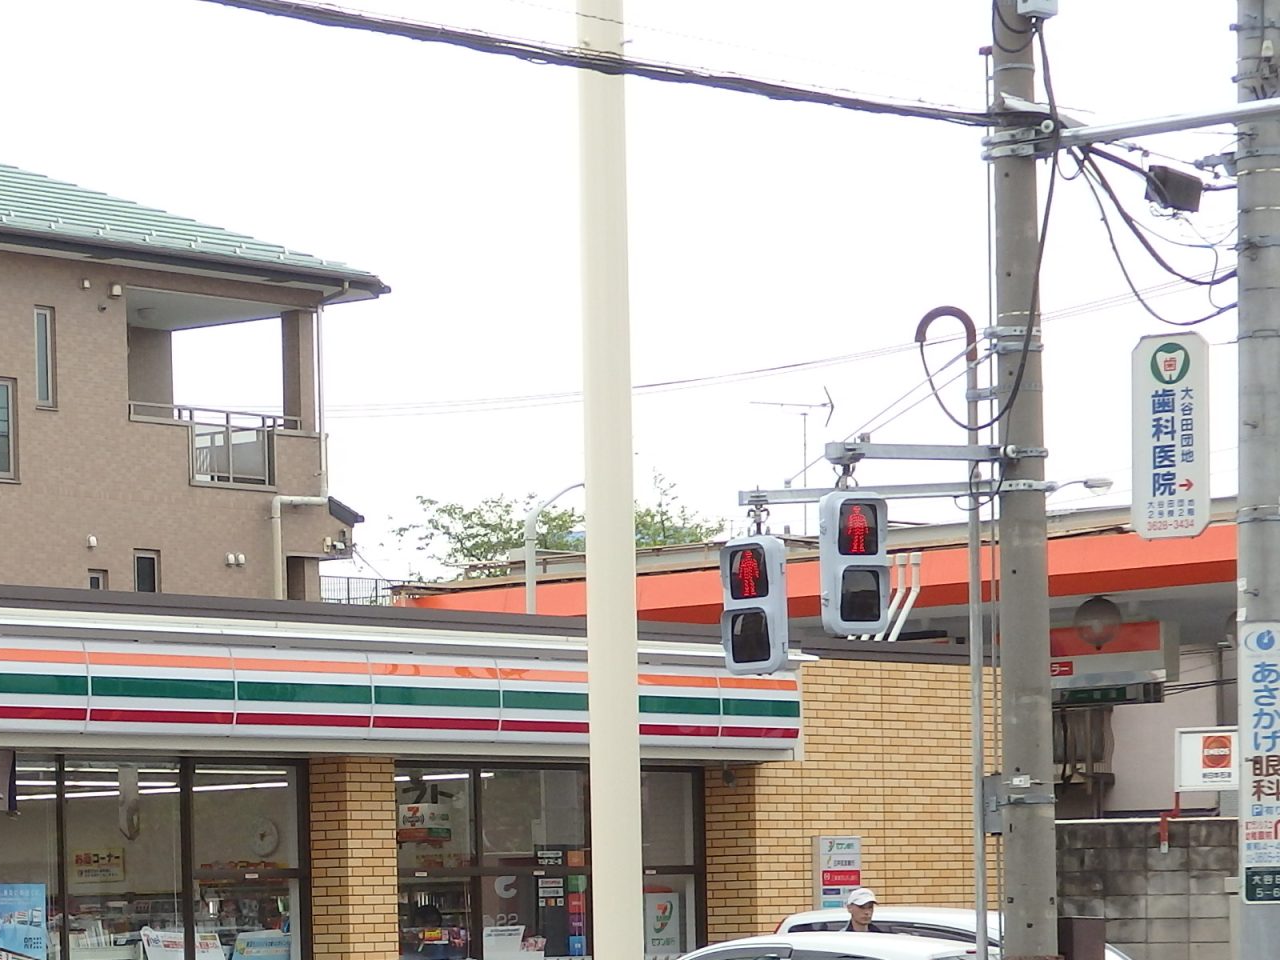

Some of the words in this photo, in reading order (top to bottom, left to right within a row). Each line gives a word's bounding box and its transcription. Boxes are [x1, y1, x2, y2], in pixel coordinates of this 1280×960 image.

[1163, 357, 1177, 372] 歯
[1151, 388, 1177, 498] 歯科医院
[1180, 386, 1195, 463] 大谷田団地
